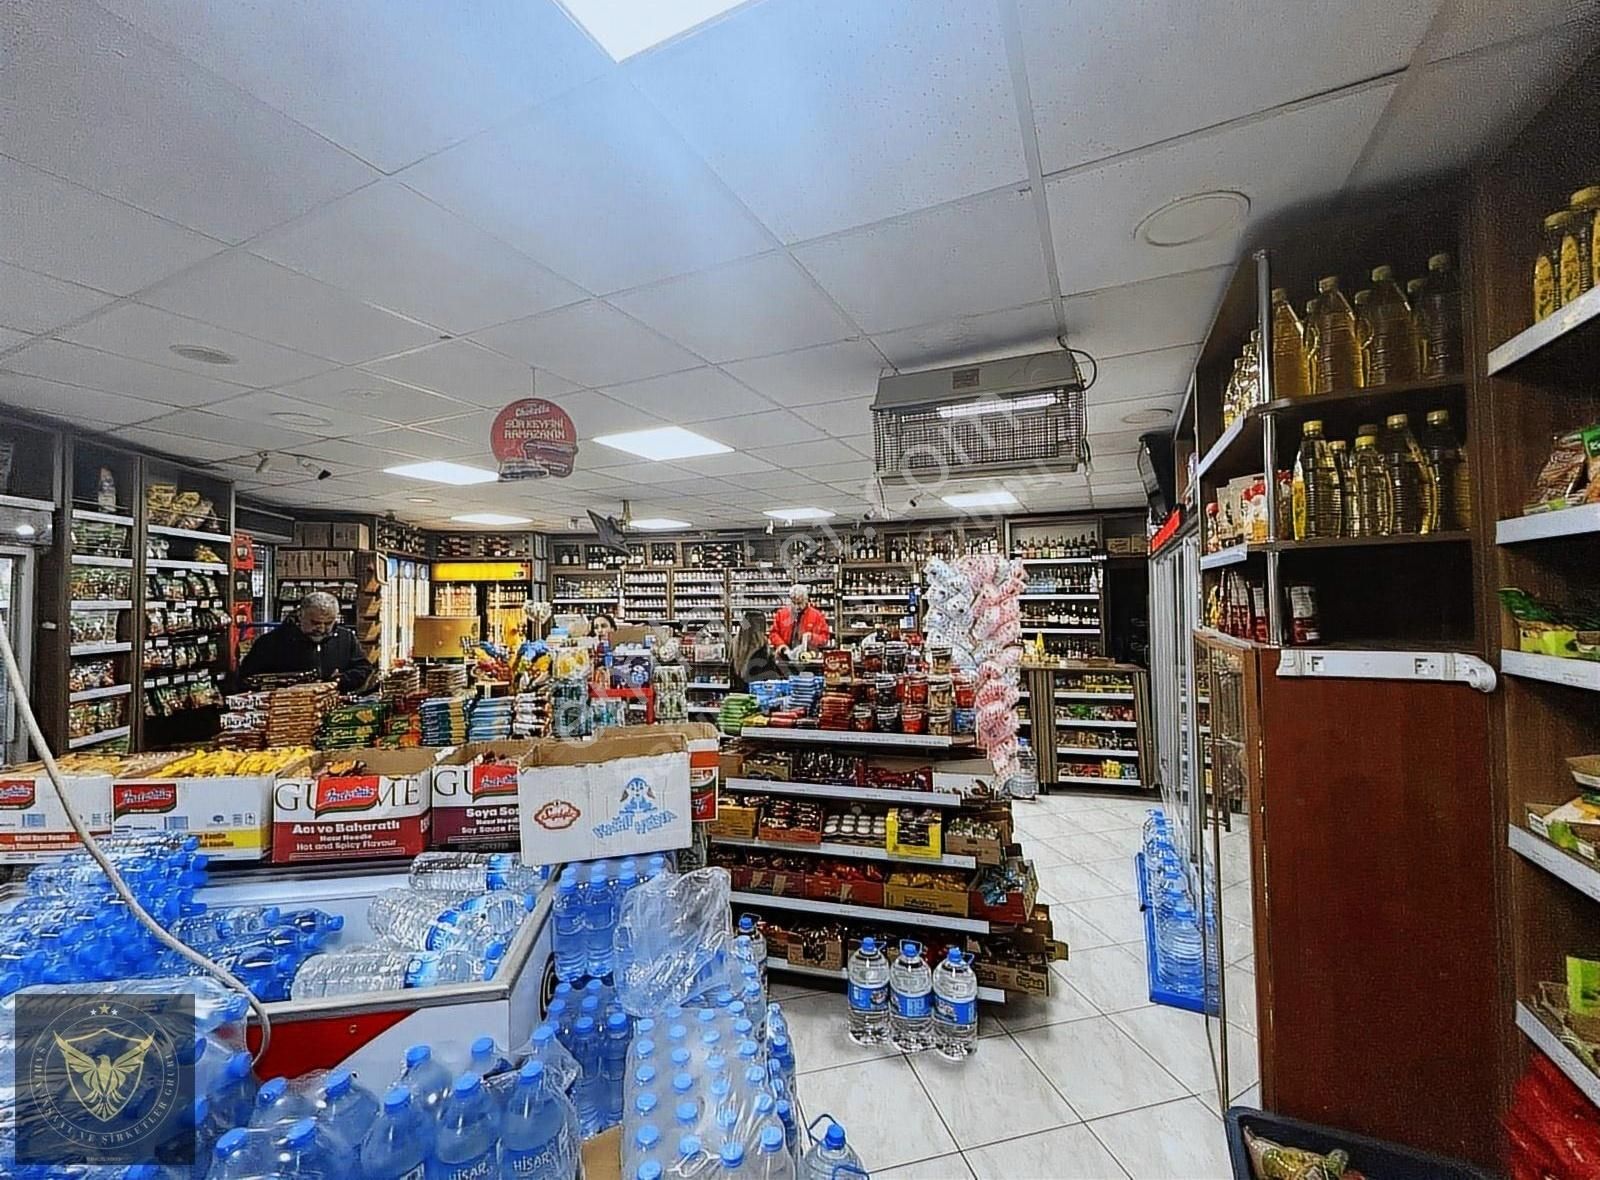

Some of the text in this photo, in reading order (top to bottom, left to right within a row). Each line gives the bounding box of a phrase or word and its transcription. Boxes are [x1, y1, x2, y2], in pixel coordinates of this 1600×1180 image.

[466, 807, 520, 819] Soya Sos
[292, 820, 401, 834] Acı ve Baharatlı
[296, 839, 397, 851] Hot and Spicy Flavour
